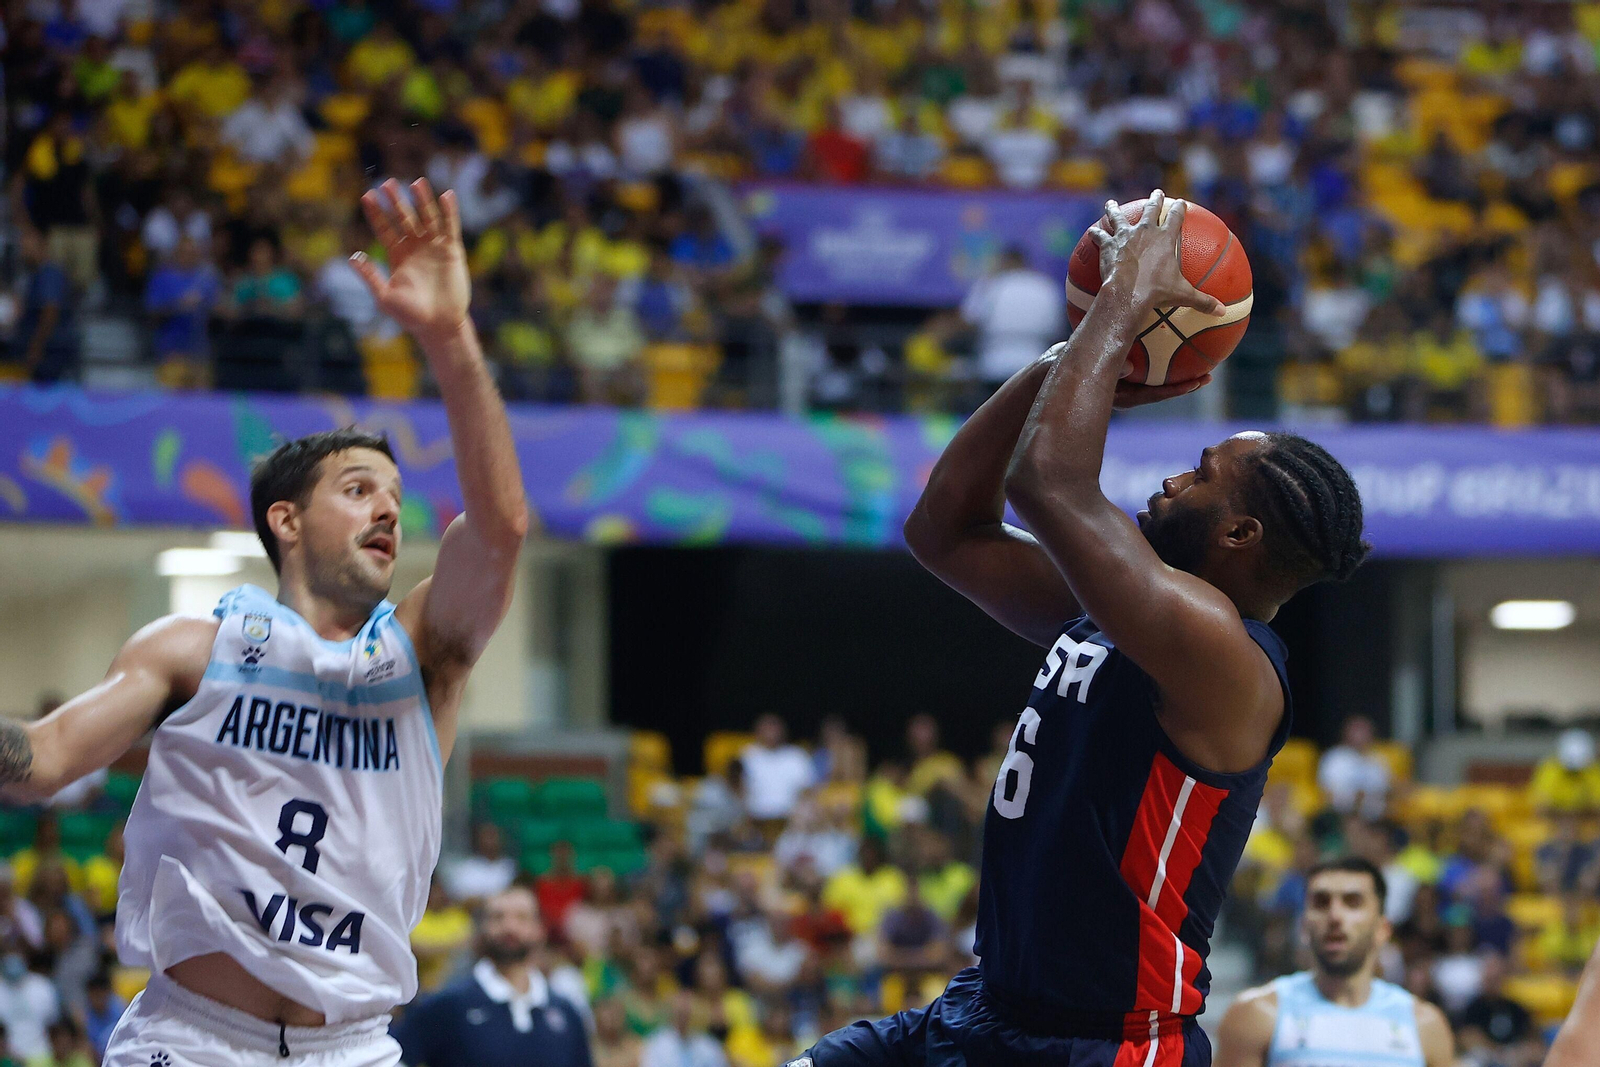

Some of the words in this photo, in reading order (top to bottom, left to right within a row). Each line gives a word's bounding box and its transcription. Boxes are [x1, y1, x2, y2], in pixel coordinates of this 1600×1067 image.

[1033, 633, 1109, 704] SA
[216, 694, 400, 771] ARGENTINA
[993, 705, 1042, 820] 6
[275, 798, 329, 875] 8
[239, 888, 366, 954] VISA
